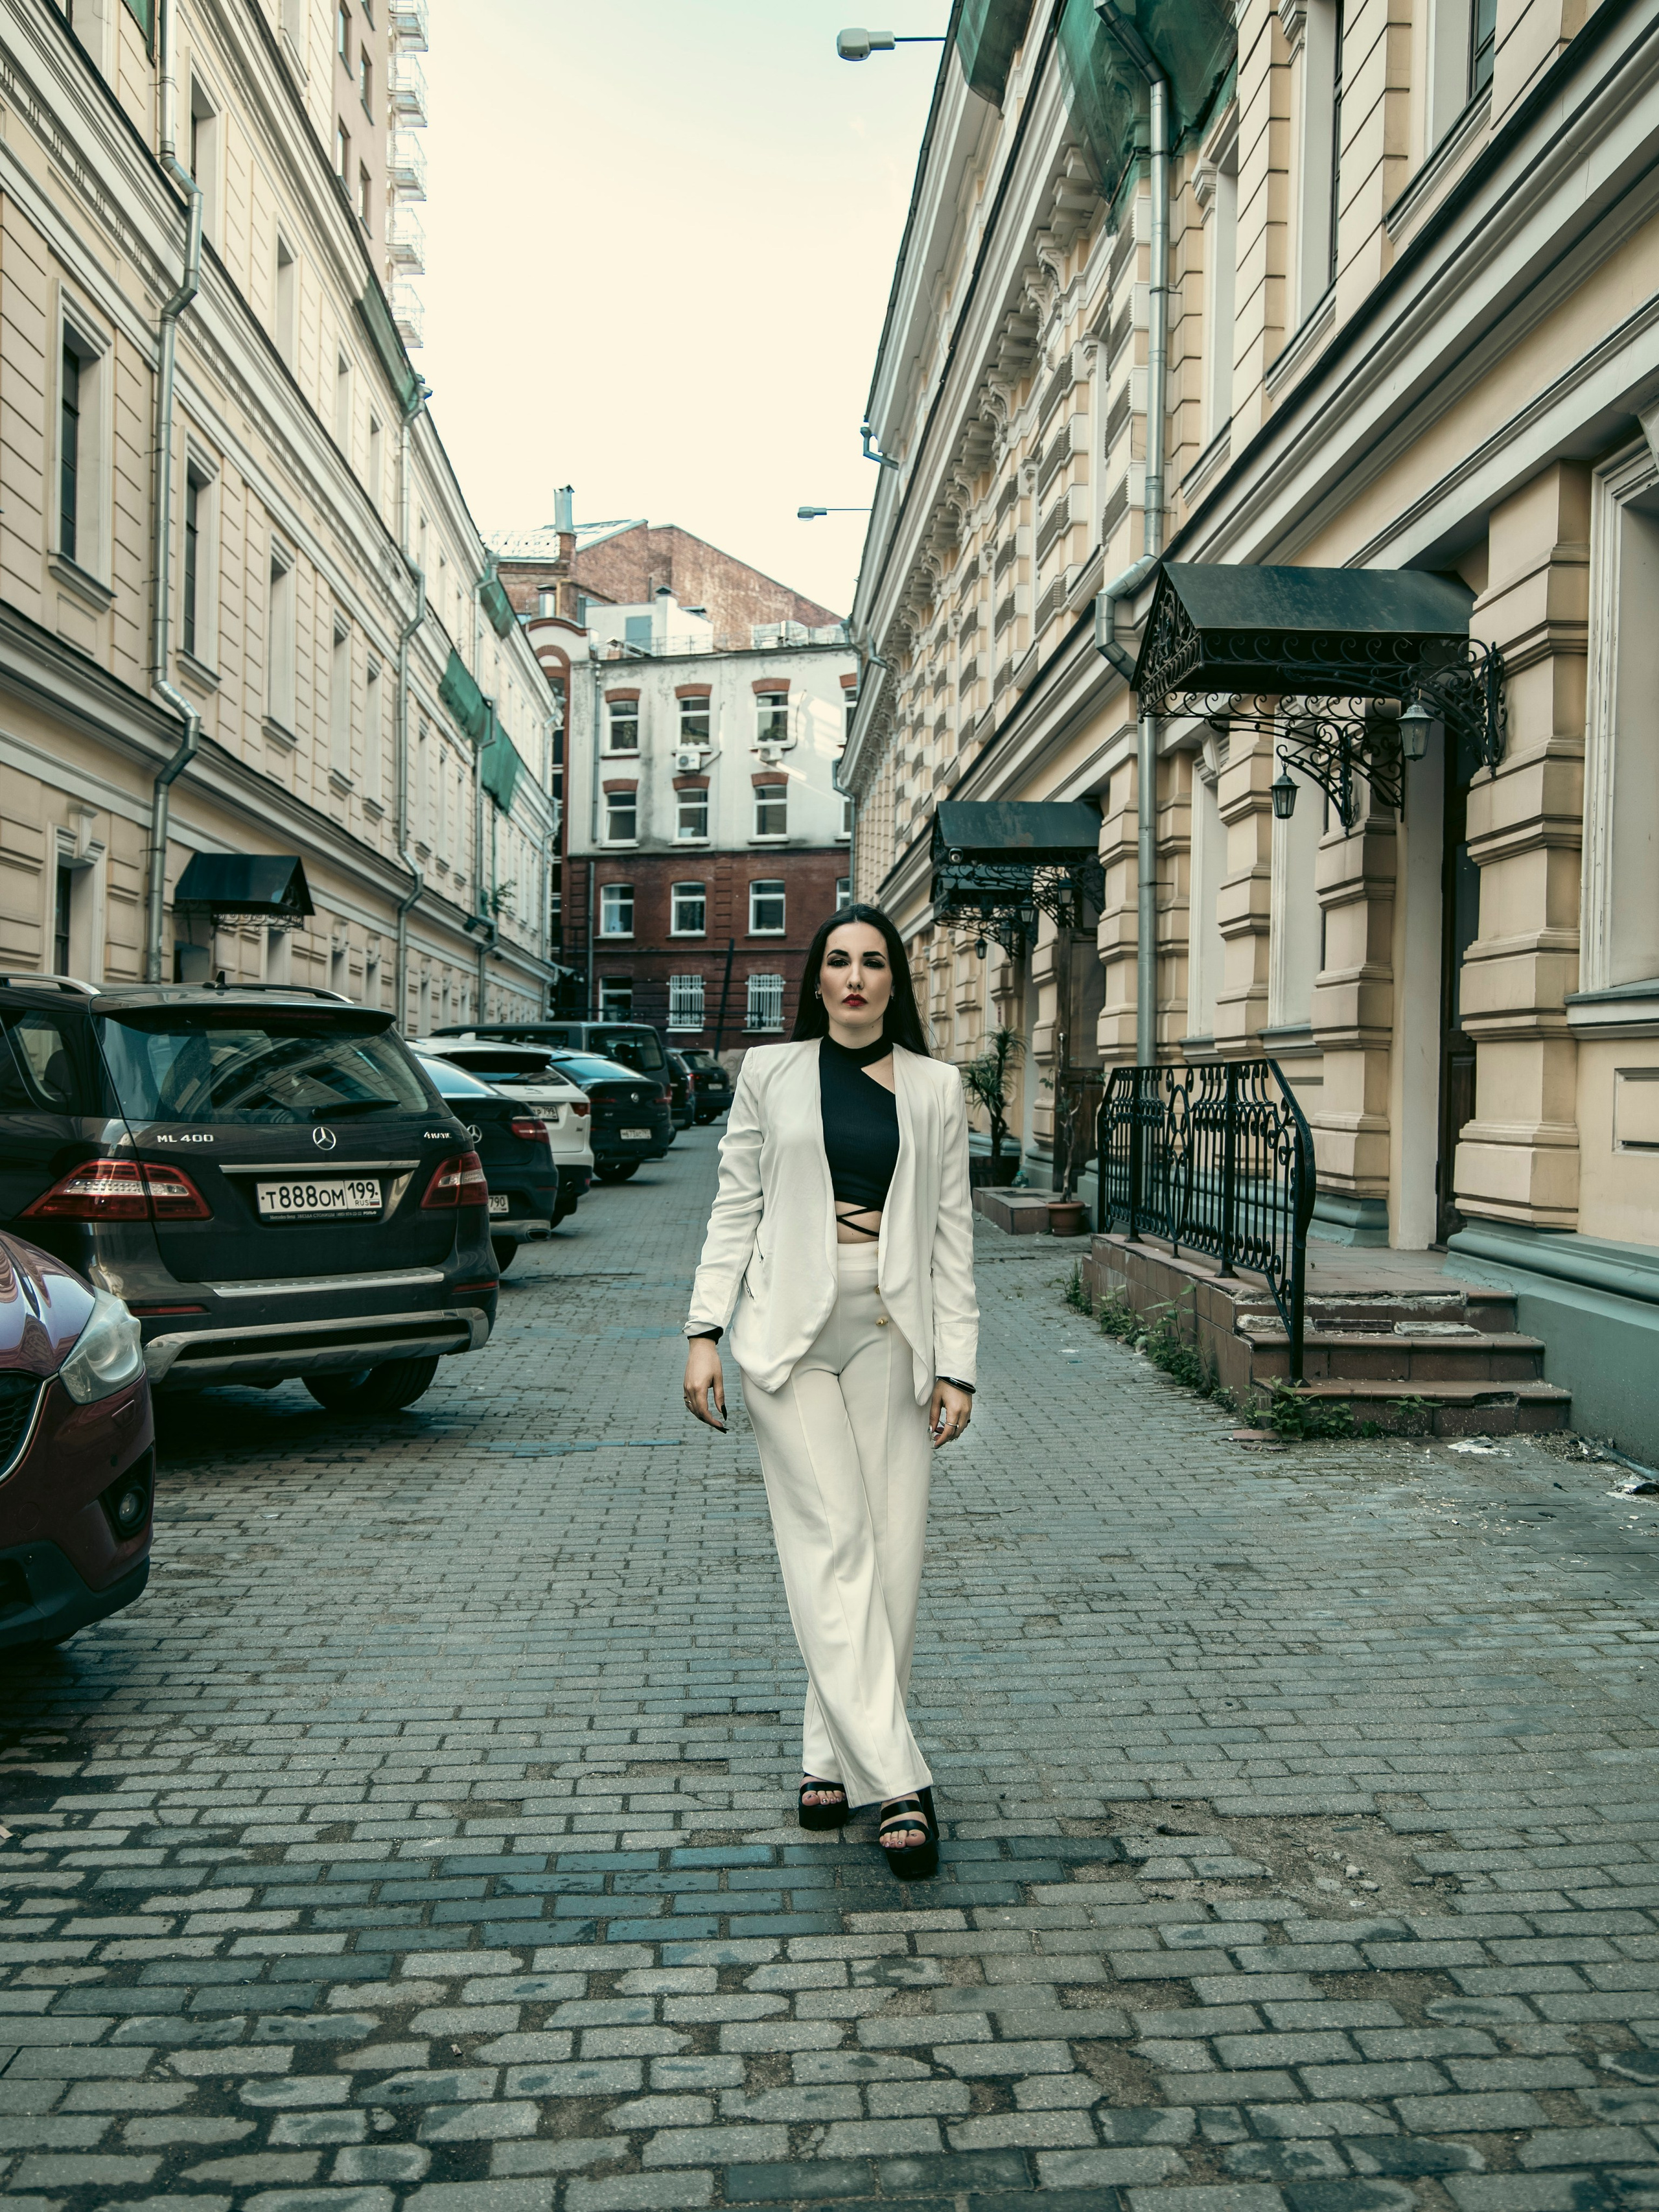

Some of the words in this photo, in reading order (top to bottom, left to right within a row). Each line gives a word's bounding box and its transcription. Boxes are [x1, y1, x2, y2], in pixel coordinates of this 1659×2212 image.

[542, 1107, 555, 1115] 799
[180, 1134, 214, 1143] 400
[266, 1185, 345, 1209] Т888ОМ
[347, 1182, 375, 1200] 199
[489, 1196, 505, 1207] 790
